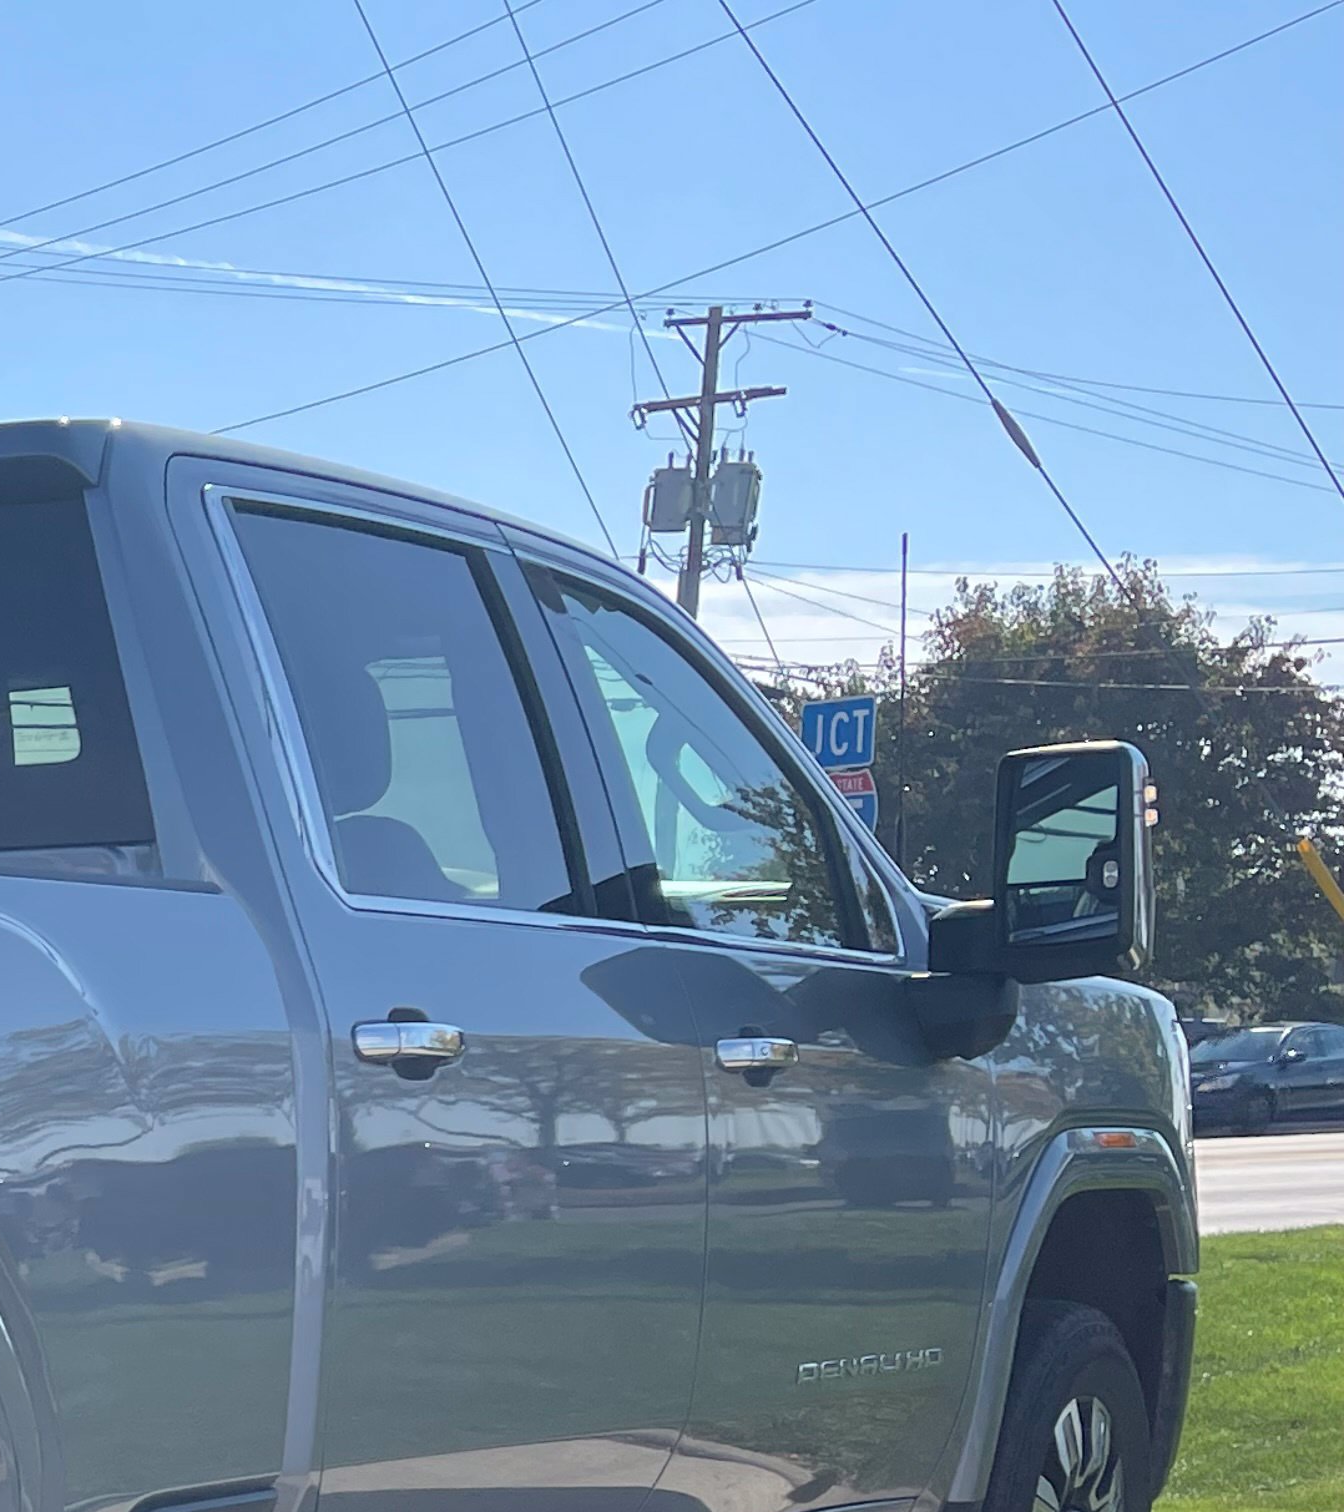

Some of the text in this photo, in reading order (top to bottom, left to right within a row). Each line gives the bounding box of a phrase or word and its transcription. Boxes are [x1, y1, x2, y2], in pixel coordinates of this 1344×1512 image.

[814, 709, 870, 756] JCT
[796, 1347, 944, 1384] DENALI HD
